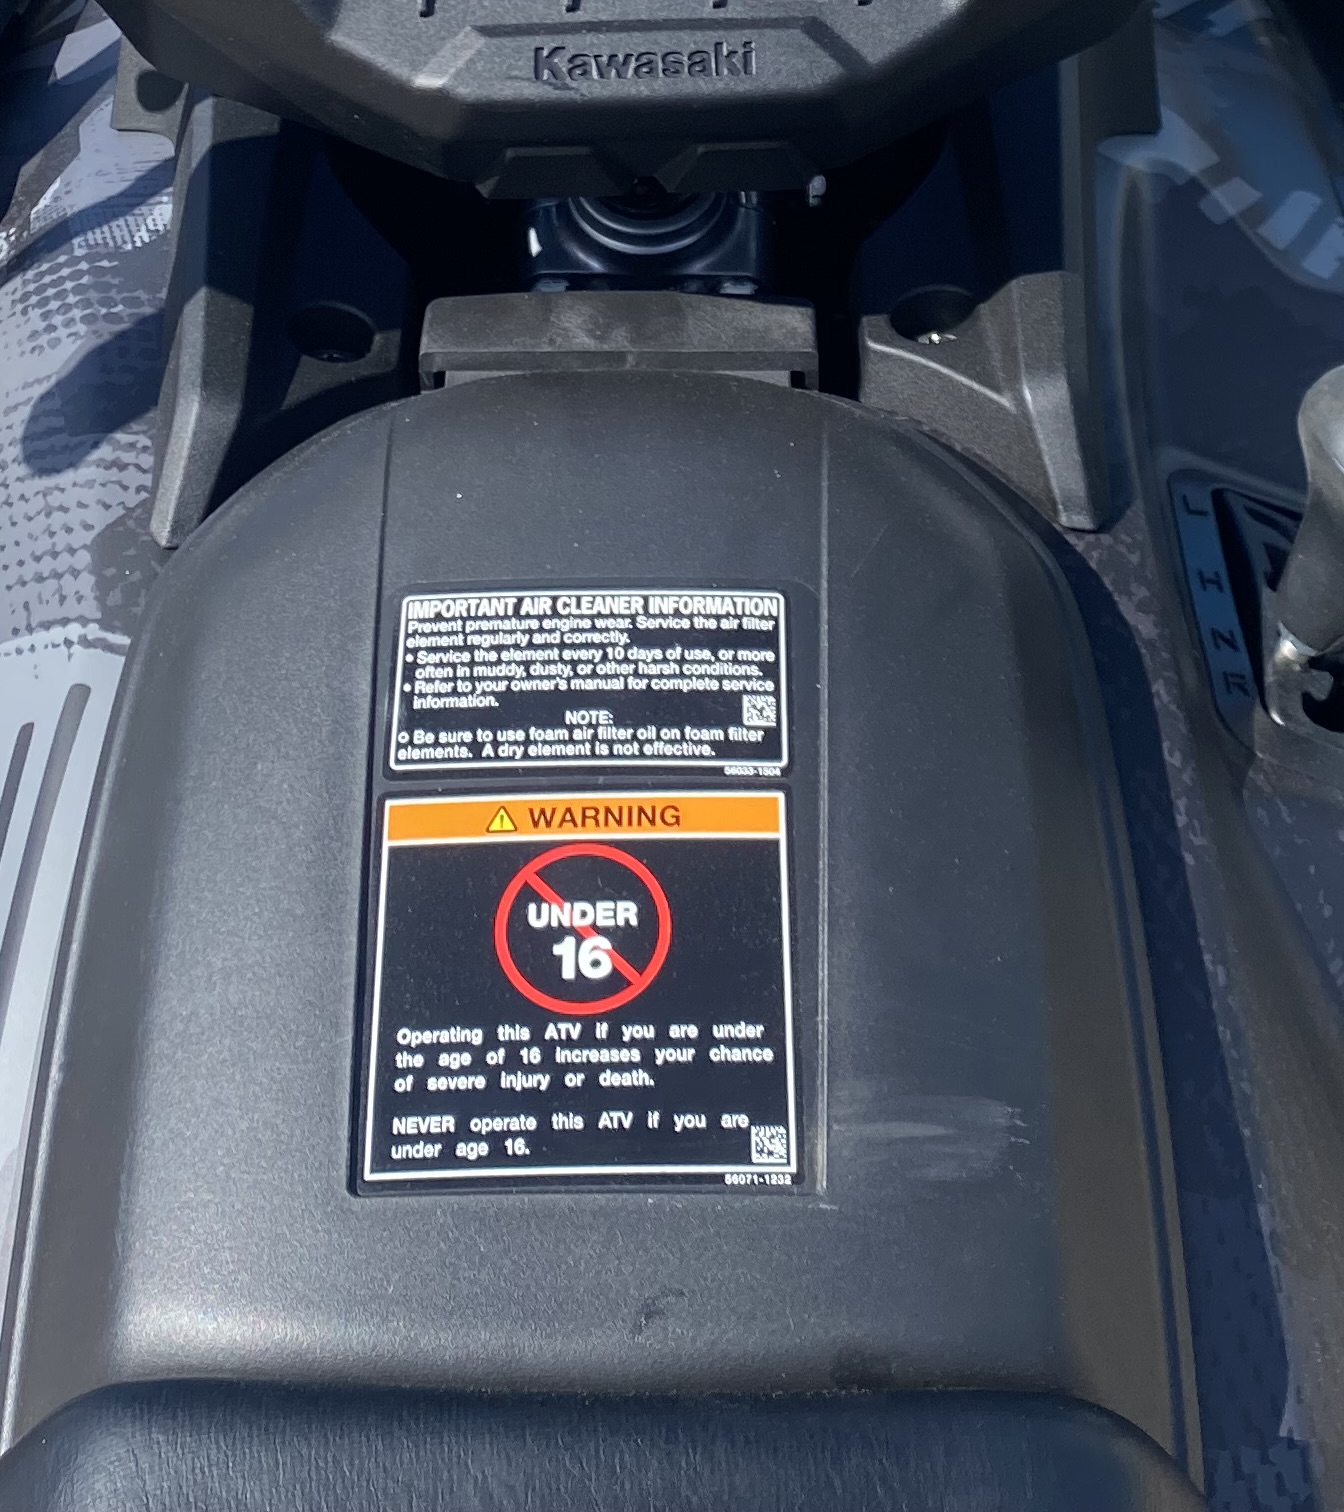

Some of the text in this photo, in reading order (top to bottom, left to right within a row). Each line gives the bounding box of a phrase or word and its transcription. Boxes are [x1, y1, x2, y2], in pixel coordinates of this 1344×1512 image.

[534, 40, 756, 82] Kawasaki
[1182, 492, 1208, 516] L
[1197, 568, 1223, 592] H
[408, 597, 777, 619] IMPORTANT AIR CLEANER INFORMATION
[408, 616, 775, 633] Prevent premature engine wear. Service the air filter
[406, 631, 630, 648] element regularly and correctly.
[1211, 627, 1239, 652] N
[416, 646, 775, 664] Service the element every 10 days of use, or more
[415, 662, 763, 679] often in muddy, dusty, or other harsh conditions.
[414, 677, 774, 693] Refer to your owner's manual for complete service
[1223, 671, 1249, 697] R
[413, 695, 499, 709] information.
[565, 711, 613, 724] NOTE:
[413, 726, 764, 744] Be sure to use foam air filter oil on foam filter
[397, 742, 715, 760] elements. A dry element is not effective.
[528, 805, 680, 827] WARNING
[527, 900, 638, 927] UNDER
[553, 936, 612, 979] 16
[396, 1021, 764, 1046] Operating this ATV if you are under
[395, 1045, 774, 1069] the age of 16 increases your chance
[393, 1068, 654, 1092] of severe injury or death.
[392, 1110, 748, 1134] NEVER operate this ATV if you are
[391, 1137, 530, 1159] under age 16.
[725, 1173, 792, 1185] 56071-1232
